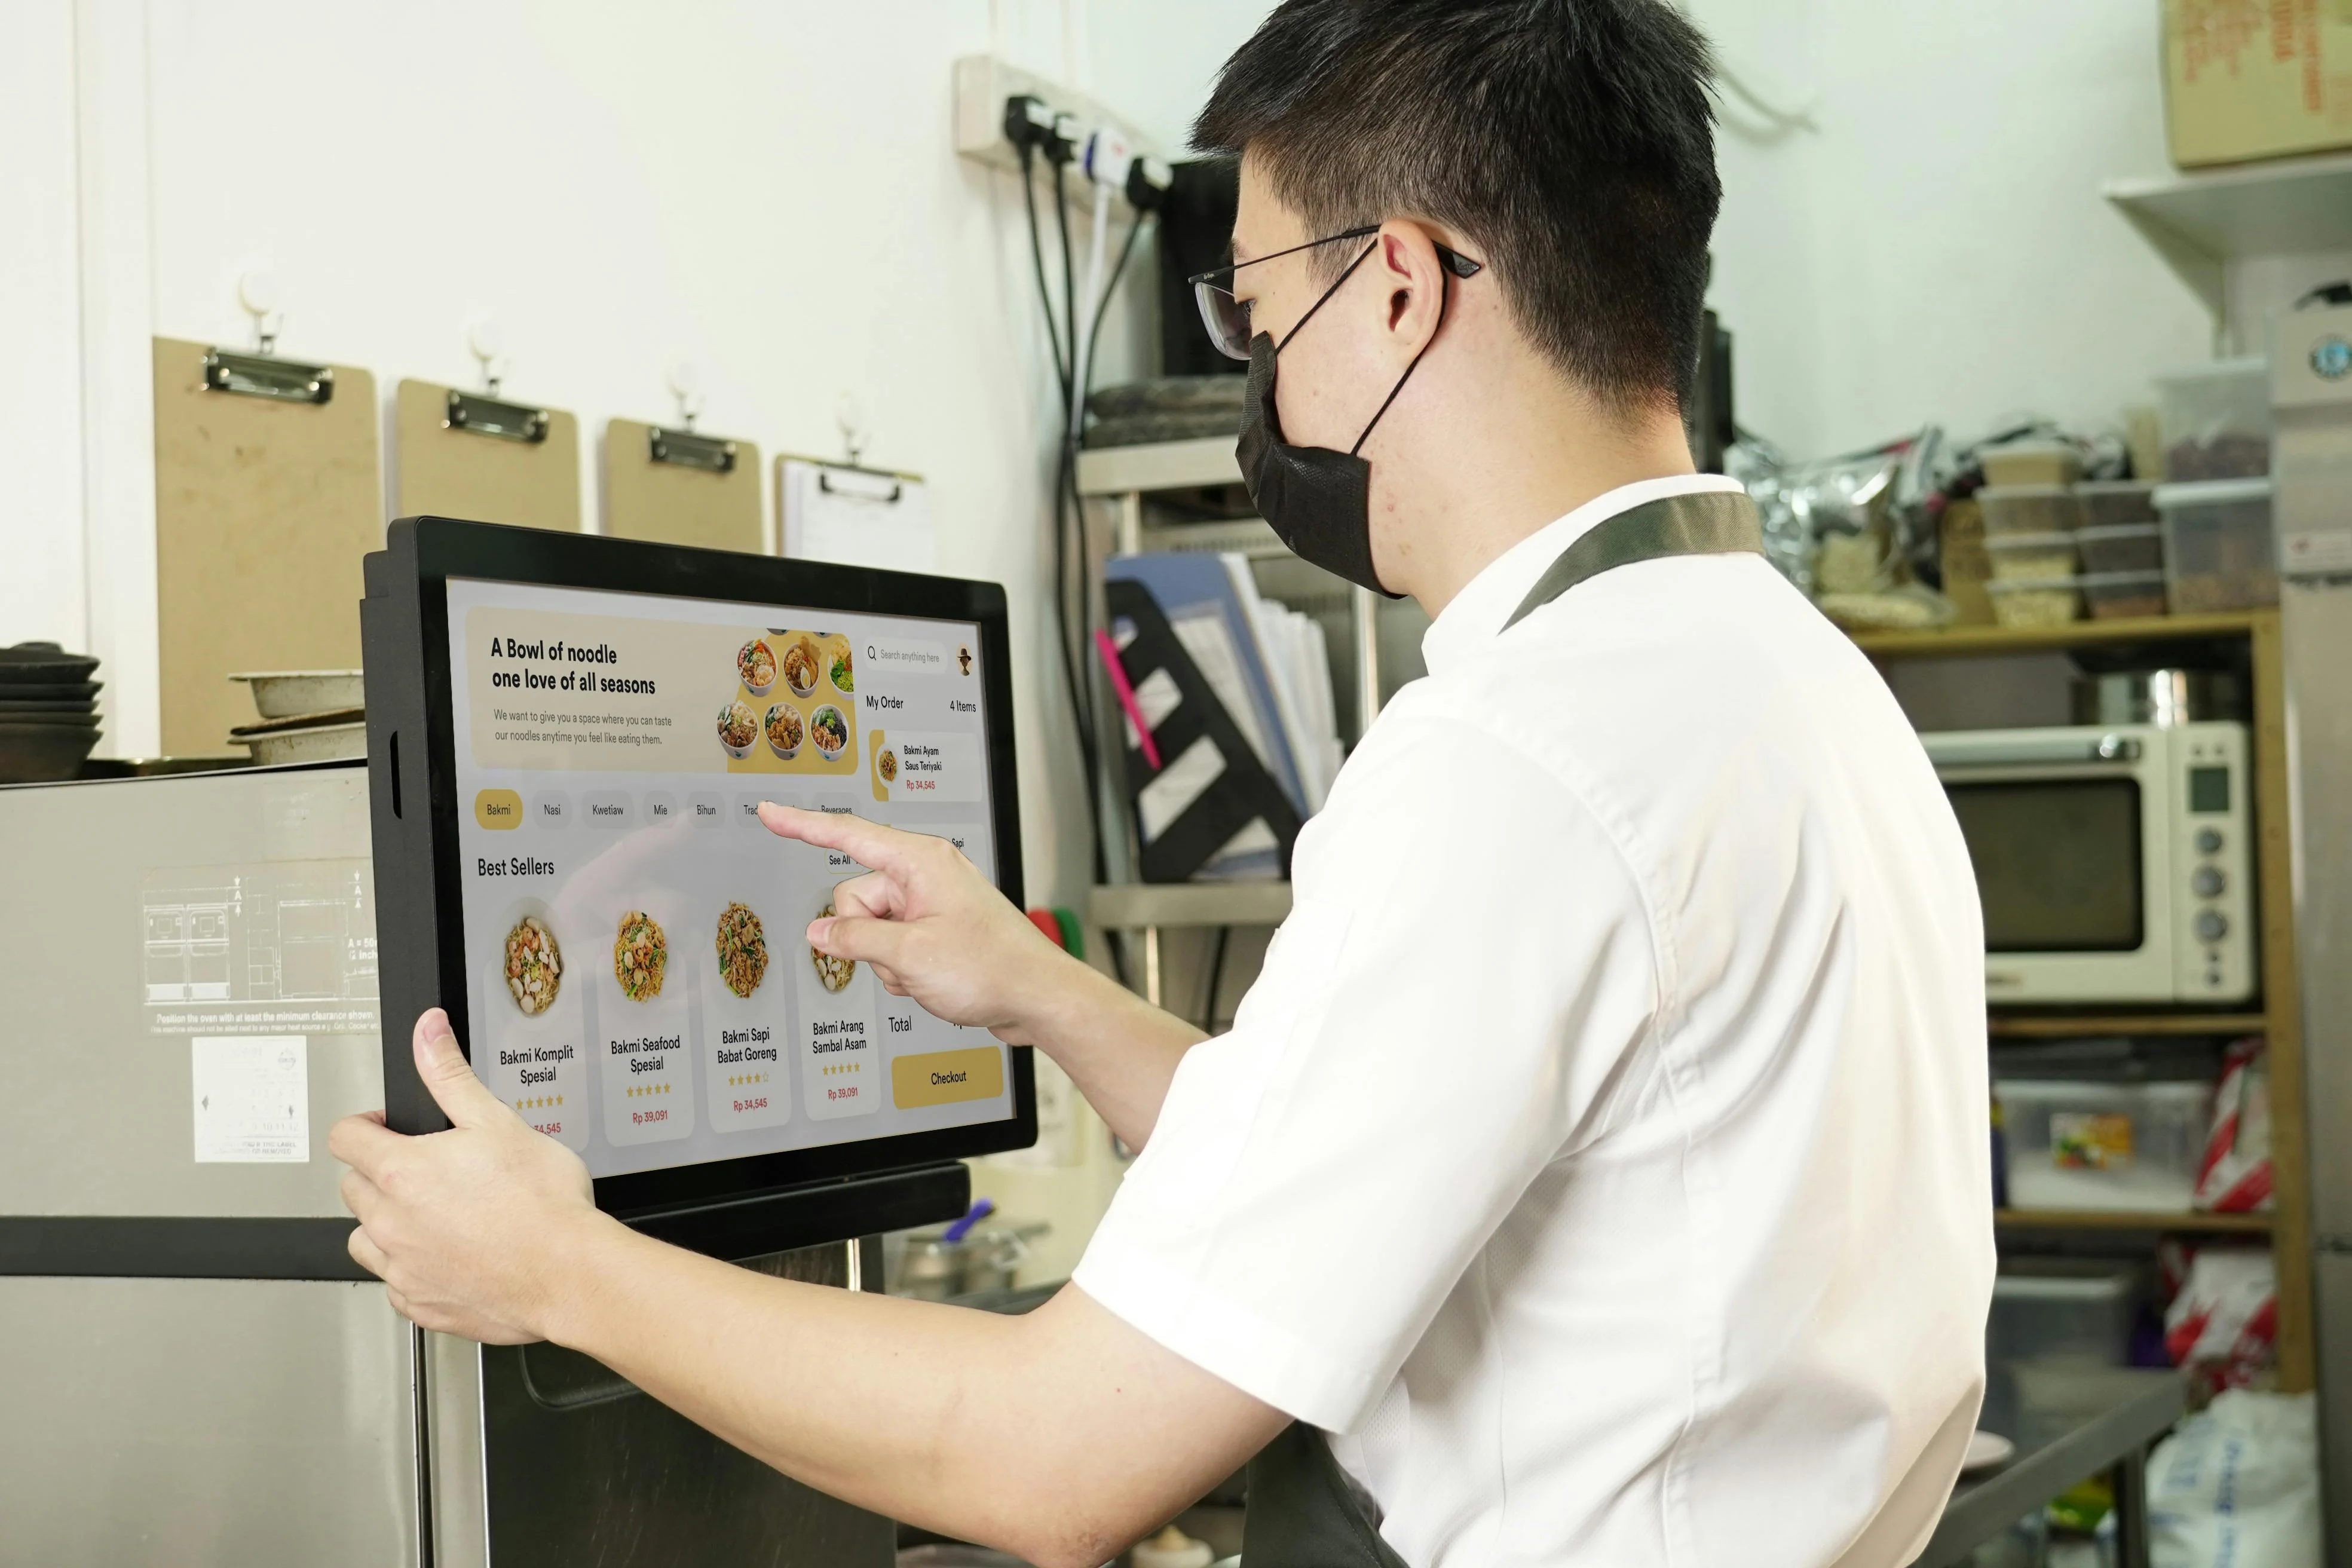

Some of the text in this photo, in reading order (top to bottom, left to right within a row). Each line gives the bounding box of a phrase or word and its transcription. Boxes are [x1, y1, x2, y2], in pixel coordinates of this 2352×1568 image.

[491, 637, 617, 664] A Bowl of noodle
[880, 648, 939, 663] Search anything here
[492, 669, 656, 694] one love of all seasons
[866, 695, 904, 710] My Order
[950, 700, 976, 712] 4 Items
[494, 709, 672, 727] We want to give you a space where you can taste
[495, 730, 662, 746] our noodles anytime you feel like eating them.
[904, 745, 939, 757] Bakmi Ayam
[905, 761, 942, 772] Saus Teriyaki
[906, 780, 935, 791] Rp 34,545
[487, 804, 511, 815] Bakmi
[544, 804, 561, 815] Nasi
[592, 804, 623, 815] Kwetiaw
[654, 804, 667, 815] Mie
[697, 805, 716, 815] Bihun
[952, 838, 964, 848] Sapi
[478, 857, 555, 876] Best Sellers
[829, 856, 841, 865] See
[813, 1020, 863, 1035] Bakmi Arang
[889, 1015, 912, 1033] Total
[722, 1027, 770, 1044] Bakmi Sapi
[611, 1034, 680, 1055] Bakmi Seafood
[813, 1038, 866, 1054] Sambal Asam
[500, 1045, 574, 1065] Bakmi Komplit
[718, 1048, 777, 1063] Babat Goreng
[630, 1056, 664, 1075] Spesial
[520, 1066, 556, 1086] Spesial
[931, 1071, 966, 1085] Checkout
[828, 1087, 858, 1101] Rp 39,091
[733, 1098, 767, 1113] Rp 34,545
[632, 1110, 668, 1125] Rp 39,091
